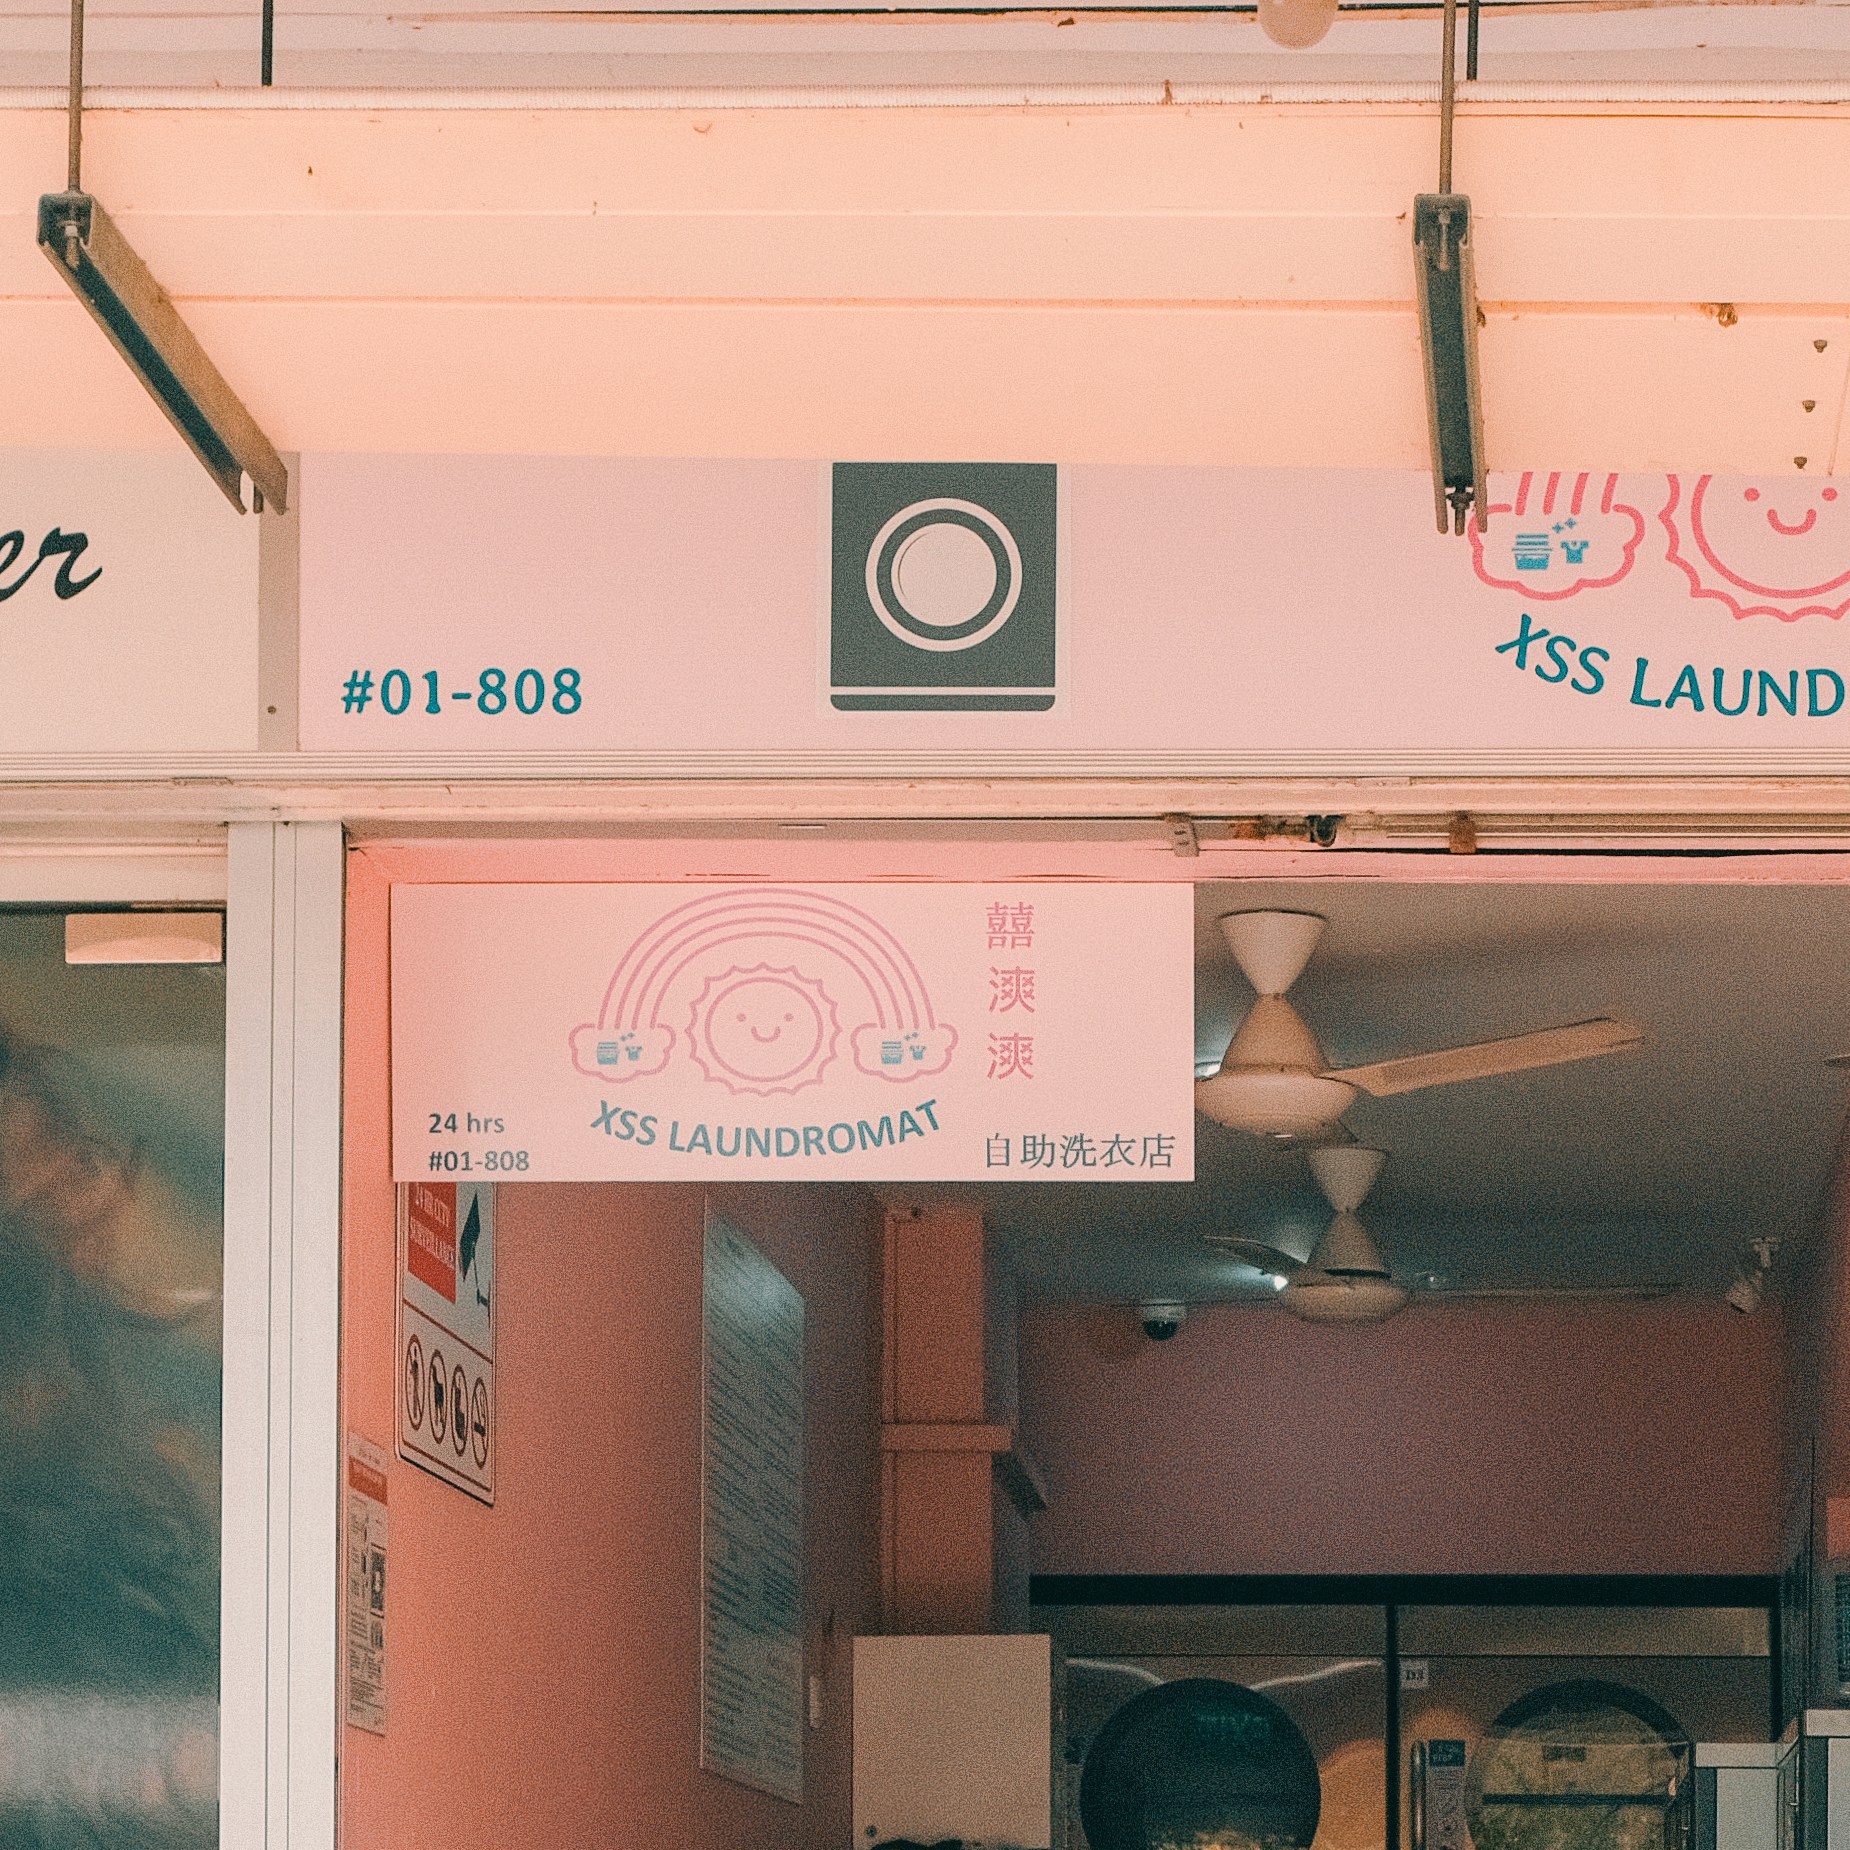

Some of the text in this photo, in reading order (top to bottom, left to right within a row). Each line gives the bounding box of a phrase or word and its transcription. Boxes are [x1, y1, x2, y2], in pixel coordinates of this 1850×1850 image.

[1495, 613, 1612, 696] XSS
[341, 667, 584, 716] #01-808
[428, 1112, 505, 1135] 24 hrs
[590, 1098, 944, 1158] XSS LAUNDROMAT
[428, 1149, 530, 1173] #01-808
[985, 1133, 1176, 1169] 自助洗衣店
